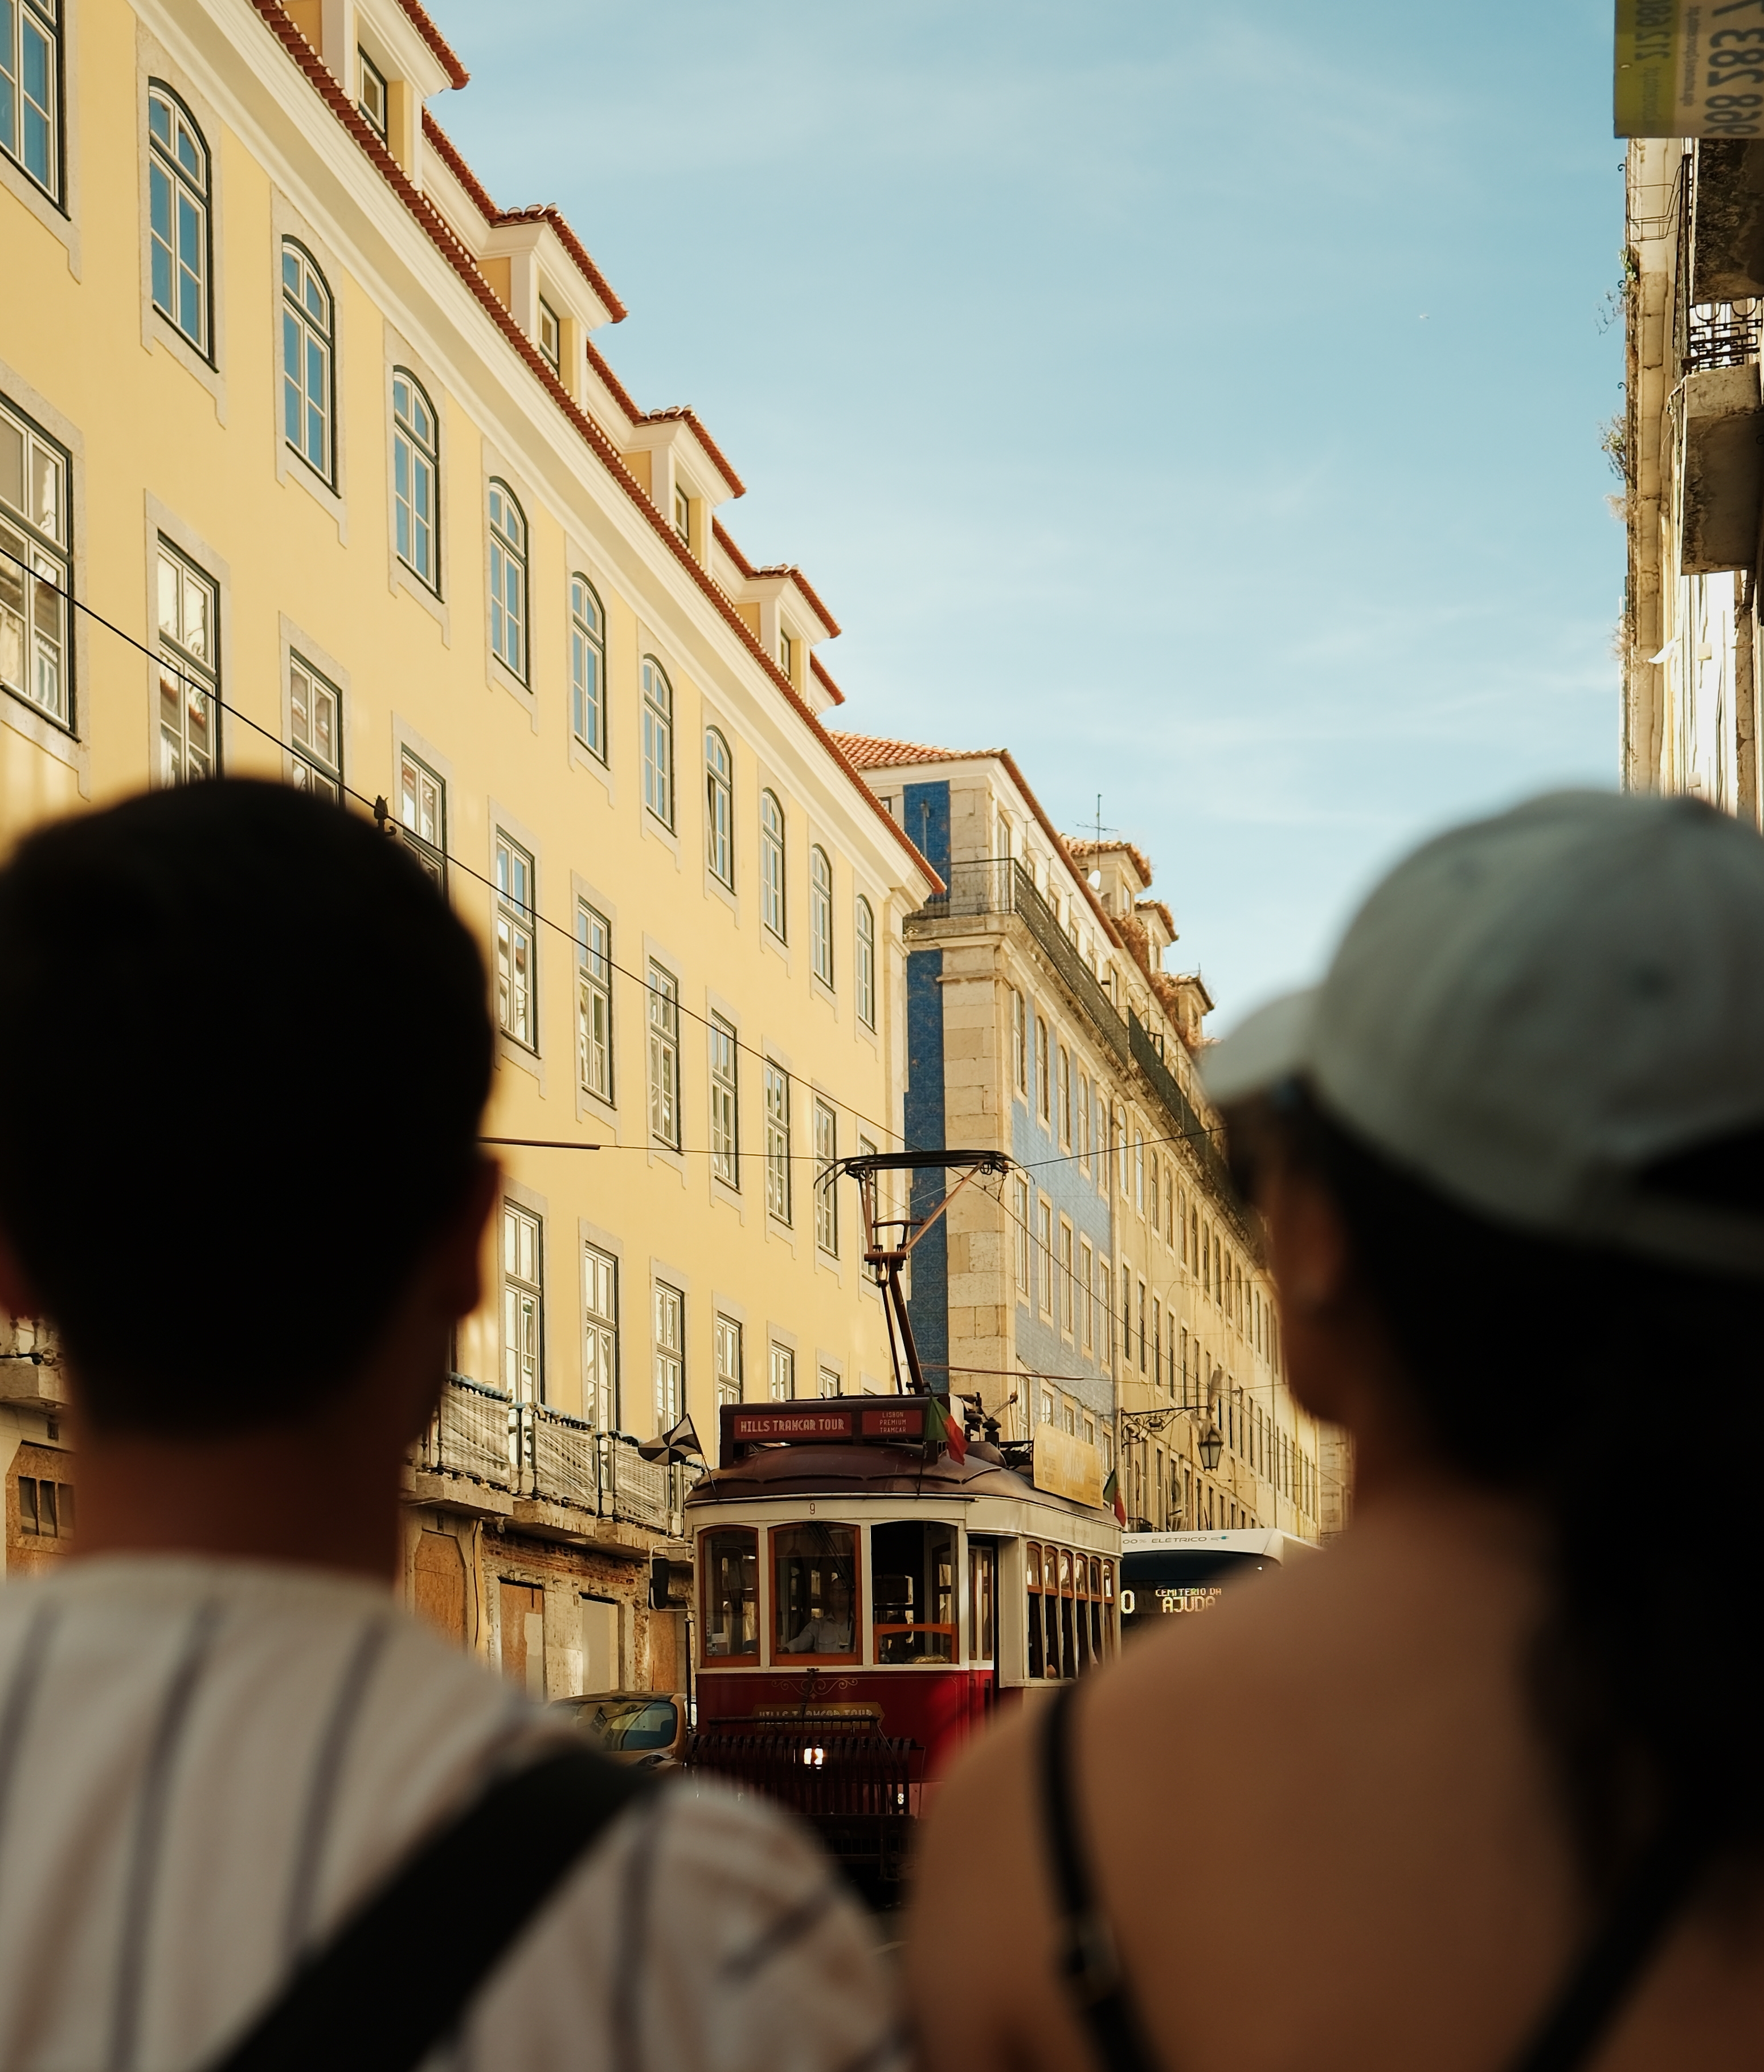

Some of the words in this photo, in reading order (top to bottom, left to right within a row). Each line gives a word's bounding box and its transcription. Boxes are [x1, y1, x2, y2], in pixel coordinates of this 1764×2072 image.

[741, 1421, 770, 1432] HILLS
[773, 1419, 816, 1431] TRAMCAR
[818, 1418, 844, 1430] TOUR
[809, 1502, 815, 1515] 9
[1120, 1590, 1135, 1614] 0
